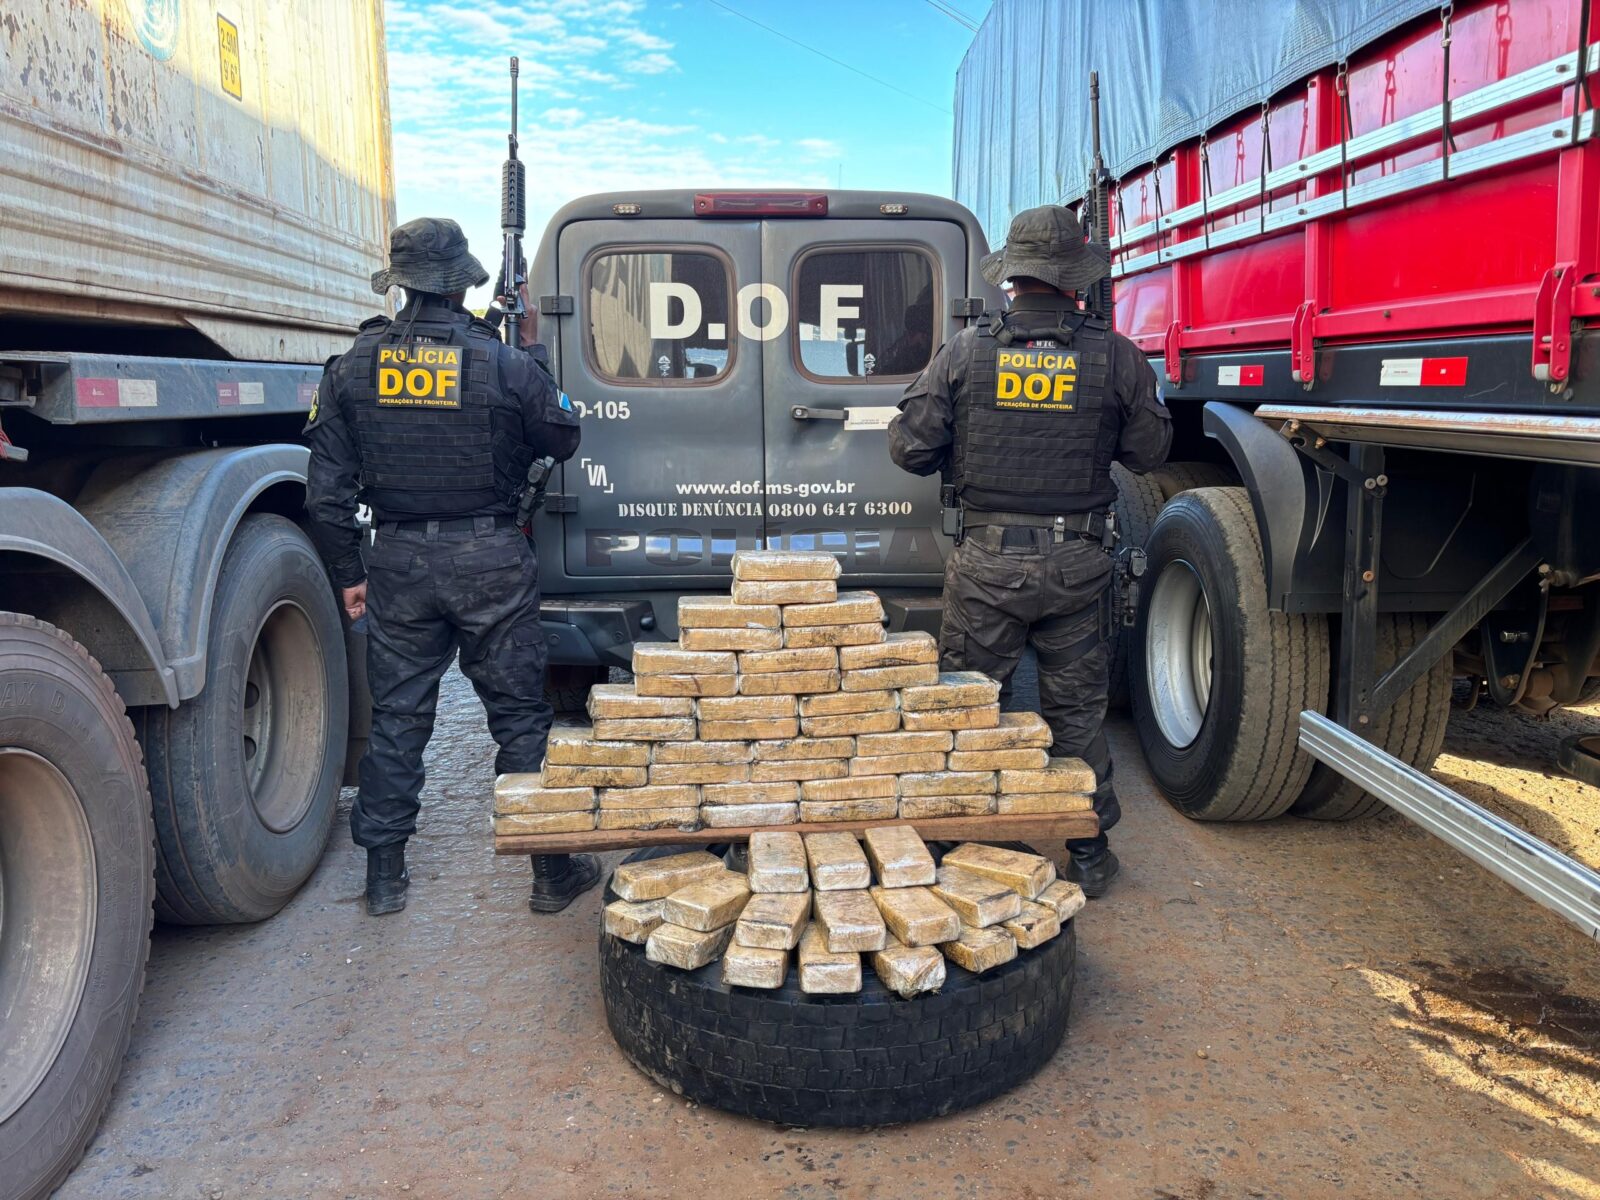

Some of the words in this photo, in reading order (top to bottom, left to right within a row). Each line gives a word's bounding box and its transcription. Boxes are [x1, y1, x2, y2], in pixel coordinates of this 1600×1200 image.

[379, 346, 458, 364] POLÍCIA
[999, 351, 1076, 370] POLÍCIA
[378, 368, 458, 397] DOF
[997, 372, 1076, 401] DOF
[618, 503, 678, 517] DISQUE
[682, 500, 763, 517] DENÚNCIA
[768, 503, 817, 517] 0800
[822, 502, 858, 516] 647
[864, 501, 912, 516] 6300
